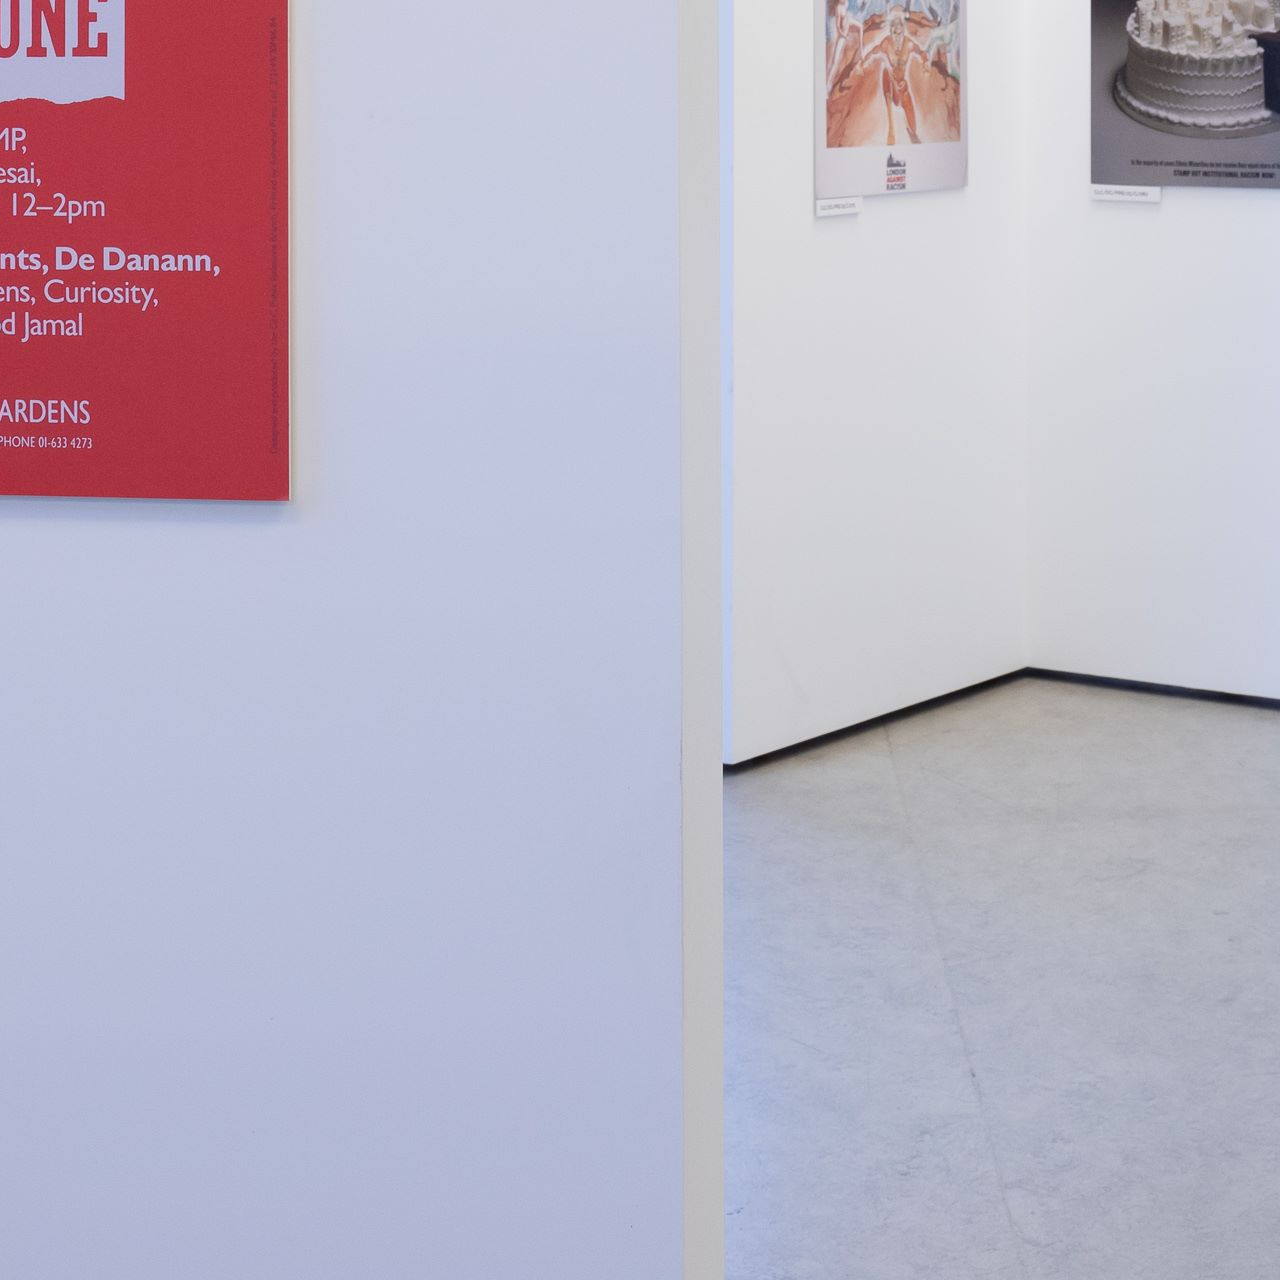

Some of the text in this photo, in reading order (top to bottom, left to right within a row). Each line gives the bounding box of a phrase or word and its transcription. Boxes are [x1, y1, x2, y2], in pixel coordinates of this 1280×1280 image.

[55, 247, 95, 271] De
[102, 247, 220, 277] Danann,
[44, 279, 159, 311] Curiosity,
[21, 311, 83, 343] Jamal
[70, 437, 93, 449] 4273
